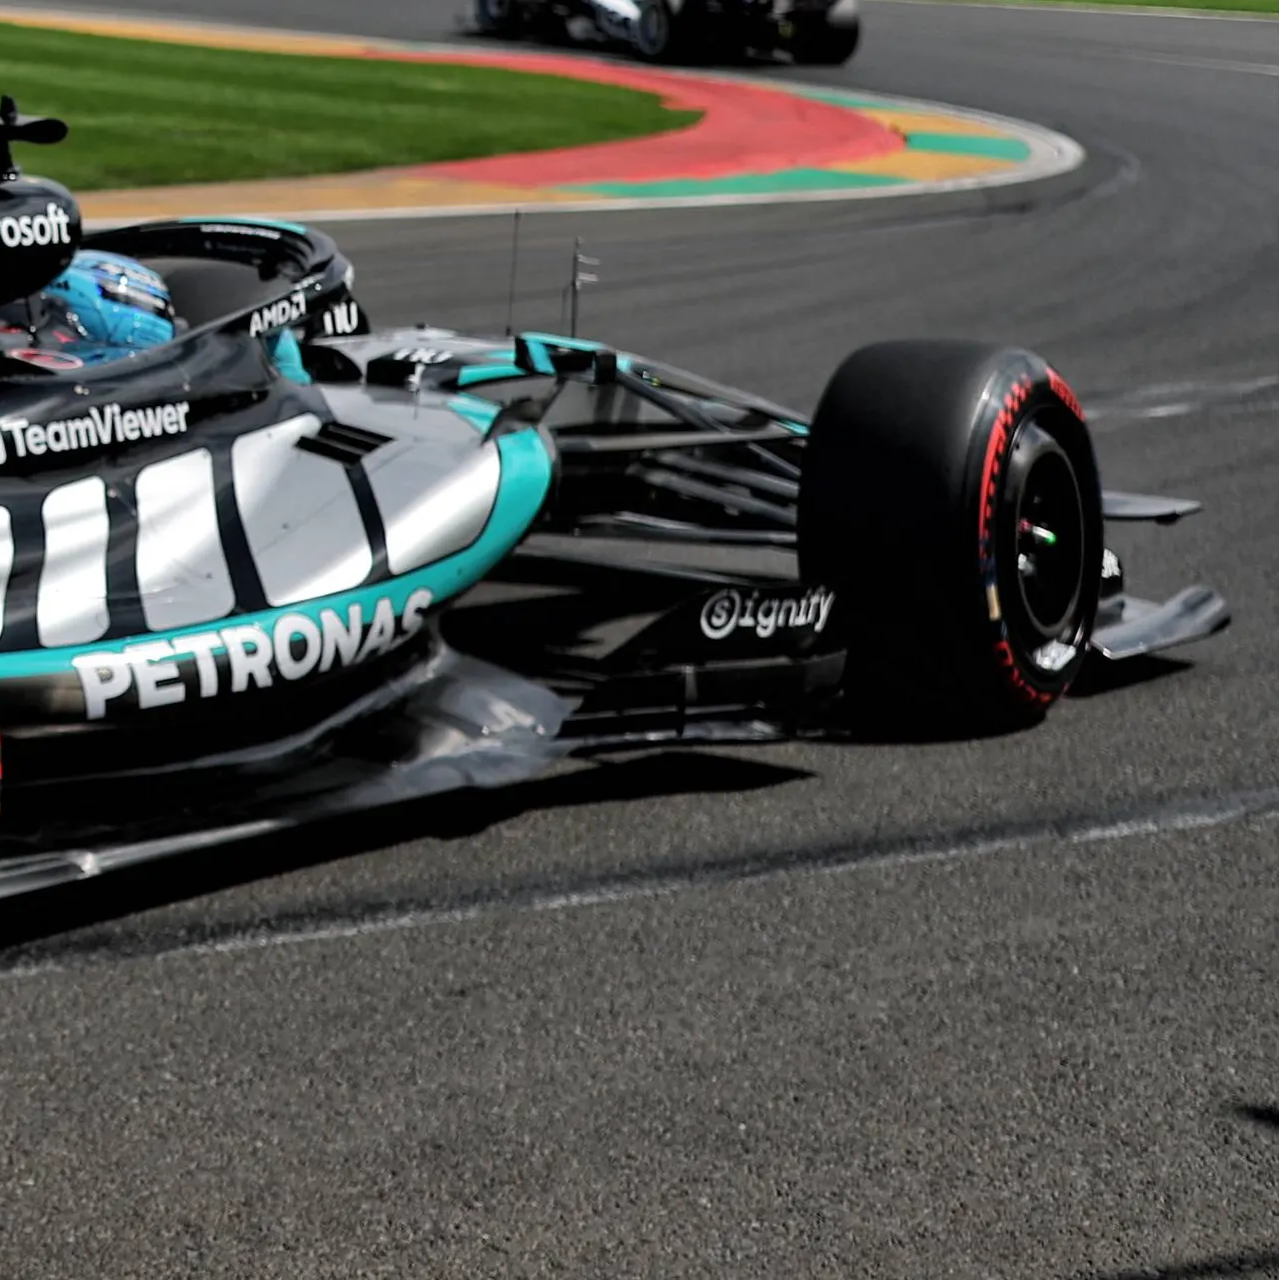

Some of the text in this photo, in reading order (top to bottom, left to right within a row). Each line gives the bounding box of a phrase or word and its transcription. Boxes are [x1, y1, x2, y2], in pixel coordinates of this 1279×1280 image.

[249, 299, 292, 338] AMD
[2, 401, 191, 458] TeamViewer
[700, 585, 836, 640] signify
[71, 587, 435, 720] PETRONAS
